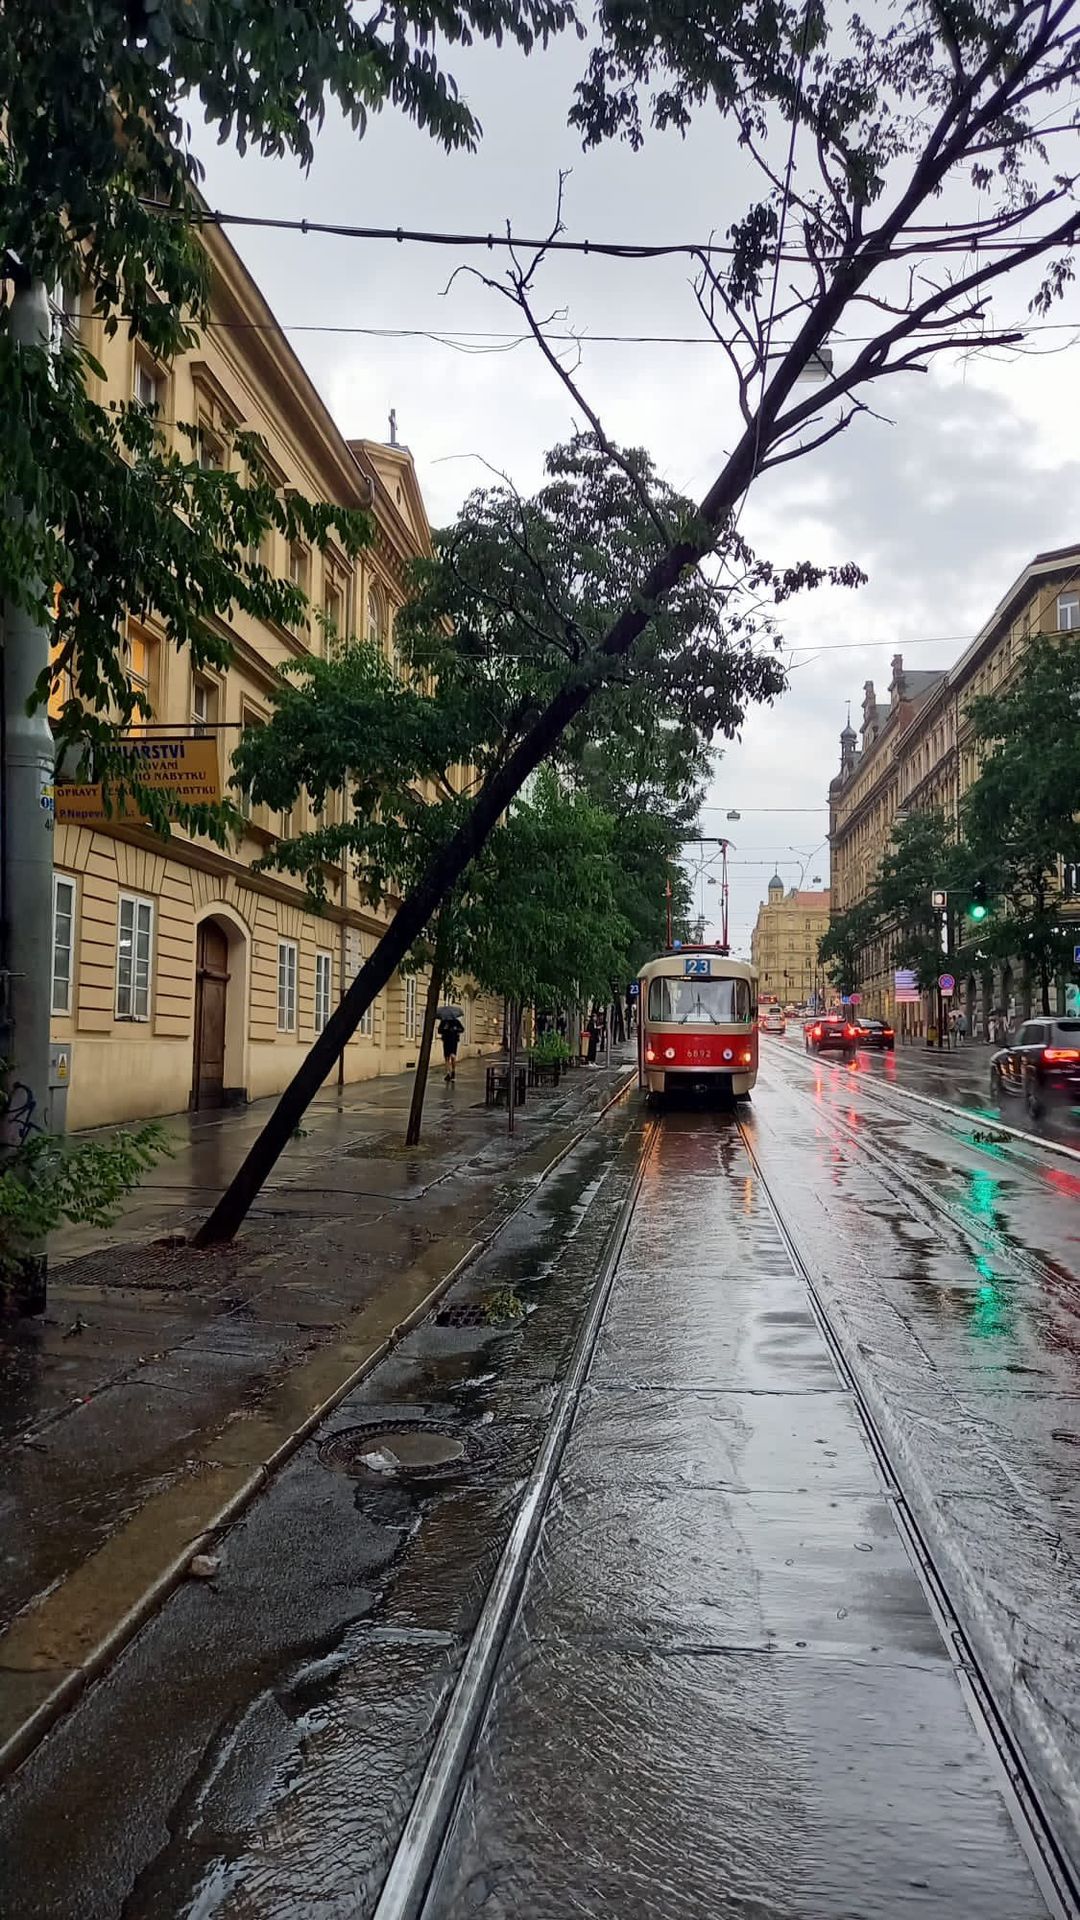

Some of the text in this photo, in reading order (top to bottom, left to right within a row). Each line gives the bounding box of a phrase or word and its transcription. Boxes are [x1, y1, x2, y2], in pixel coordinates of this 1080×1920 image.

[154, 770, 206, 781] NÁBYTKU
[57, 788, 97, 797] OPRAVY
[170, 785, 216, 795] ÁBYTKU
[687, 960, 709, 973] 23
[630, 984, 639, 994] 23
